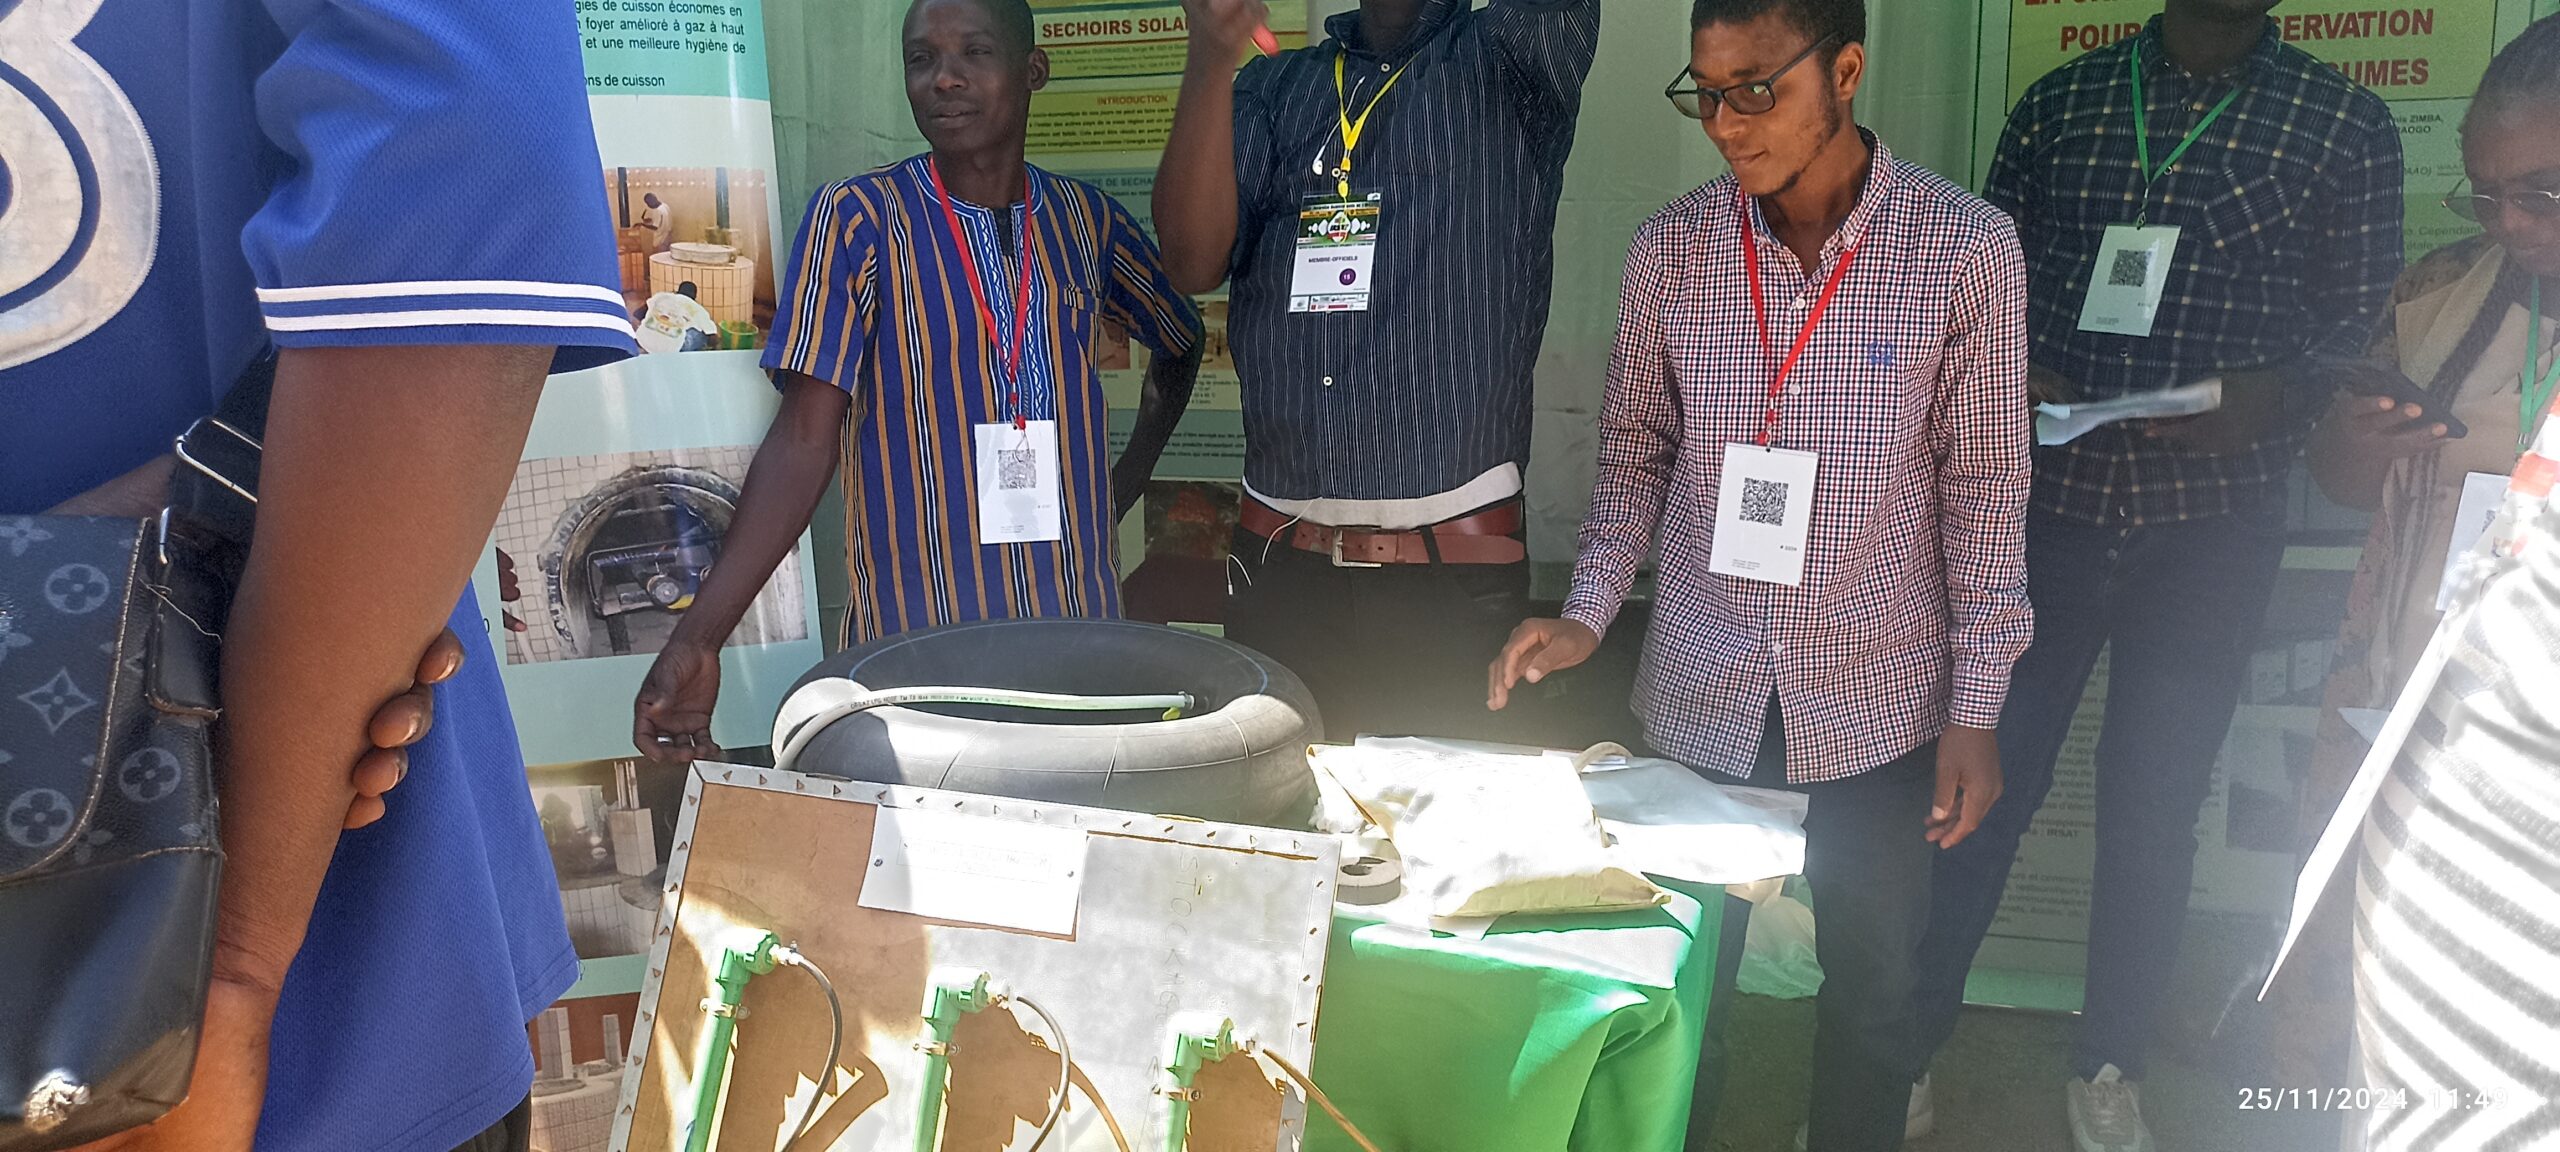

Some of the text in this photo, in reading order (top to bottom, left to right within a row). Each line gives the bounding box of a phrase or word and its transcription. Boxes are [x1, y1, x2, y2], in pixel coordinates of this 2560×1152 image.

[575, 0, 742, 16] gies de cuisson économes en
[586, 17, 744, 36] foyer amélioré à gaz à haut
[1042, 16, 1188, 38] SECHOIRS SOLAI
[2273, 8, 2434, 42] ERVATION
[586, 37, 746, 54] et une meilleure hygiène de
[585, 74, 665, 87] ns de cuisson
[2328, 58, 2430, 87] UMES
[1096, 95, 1168, 106] INTRODUCTION
[2398, 126, 2432, 135] AOGO
[1120, 176, 1153, 187] SECHA
